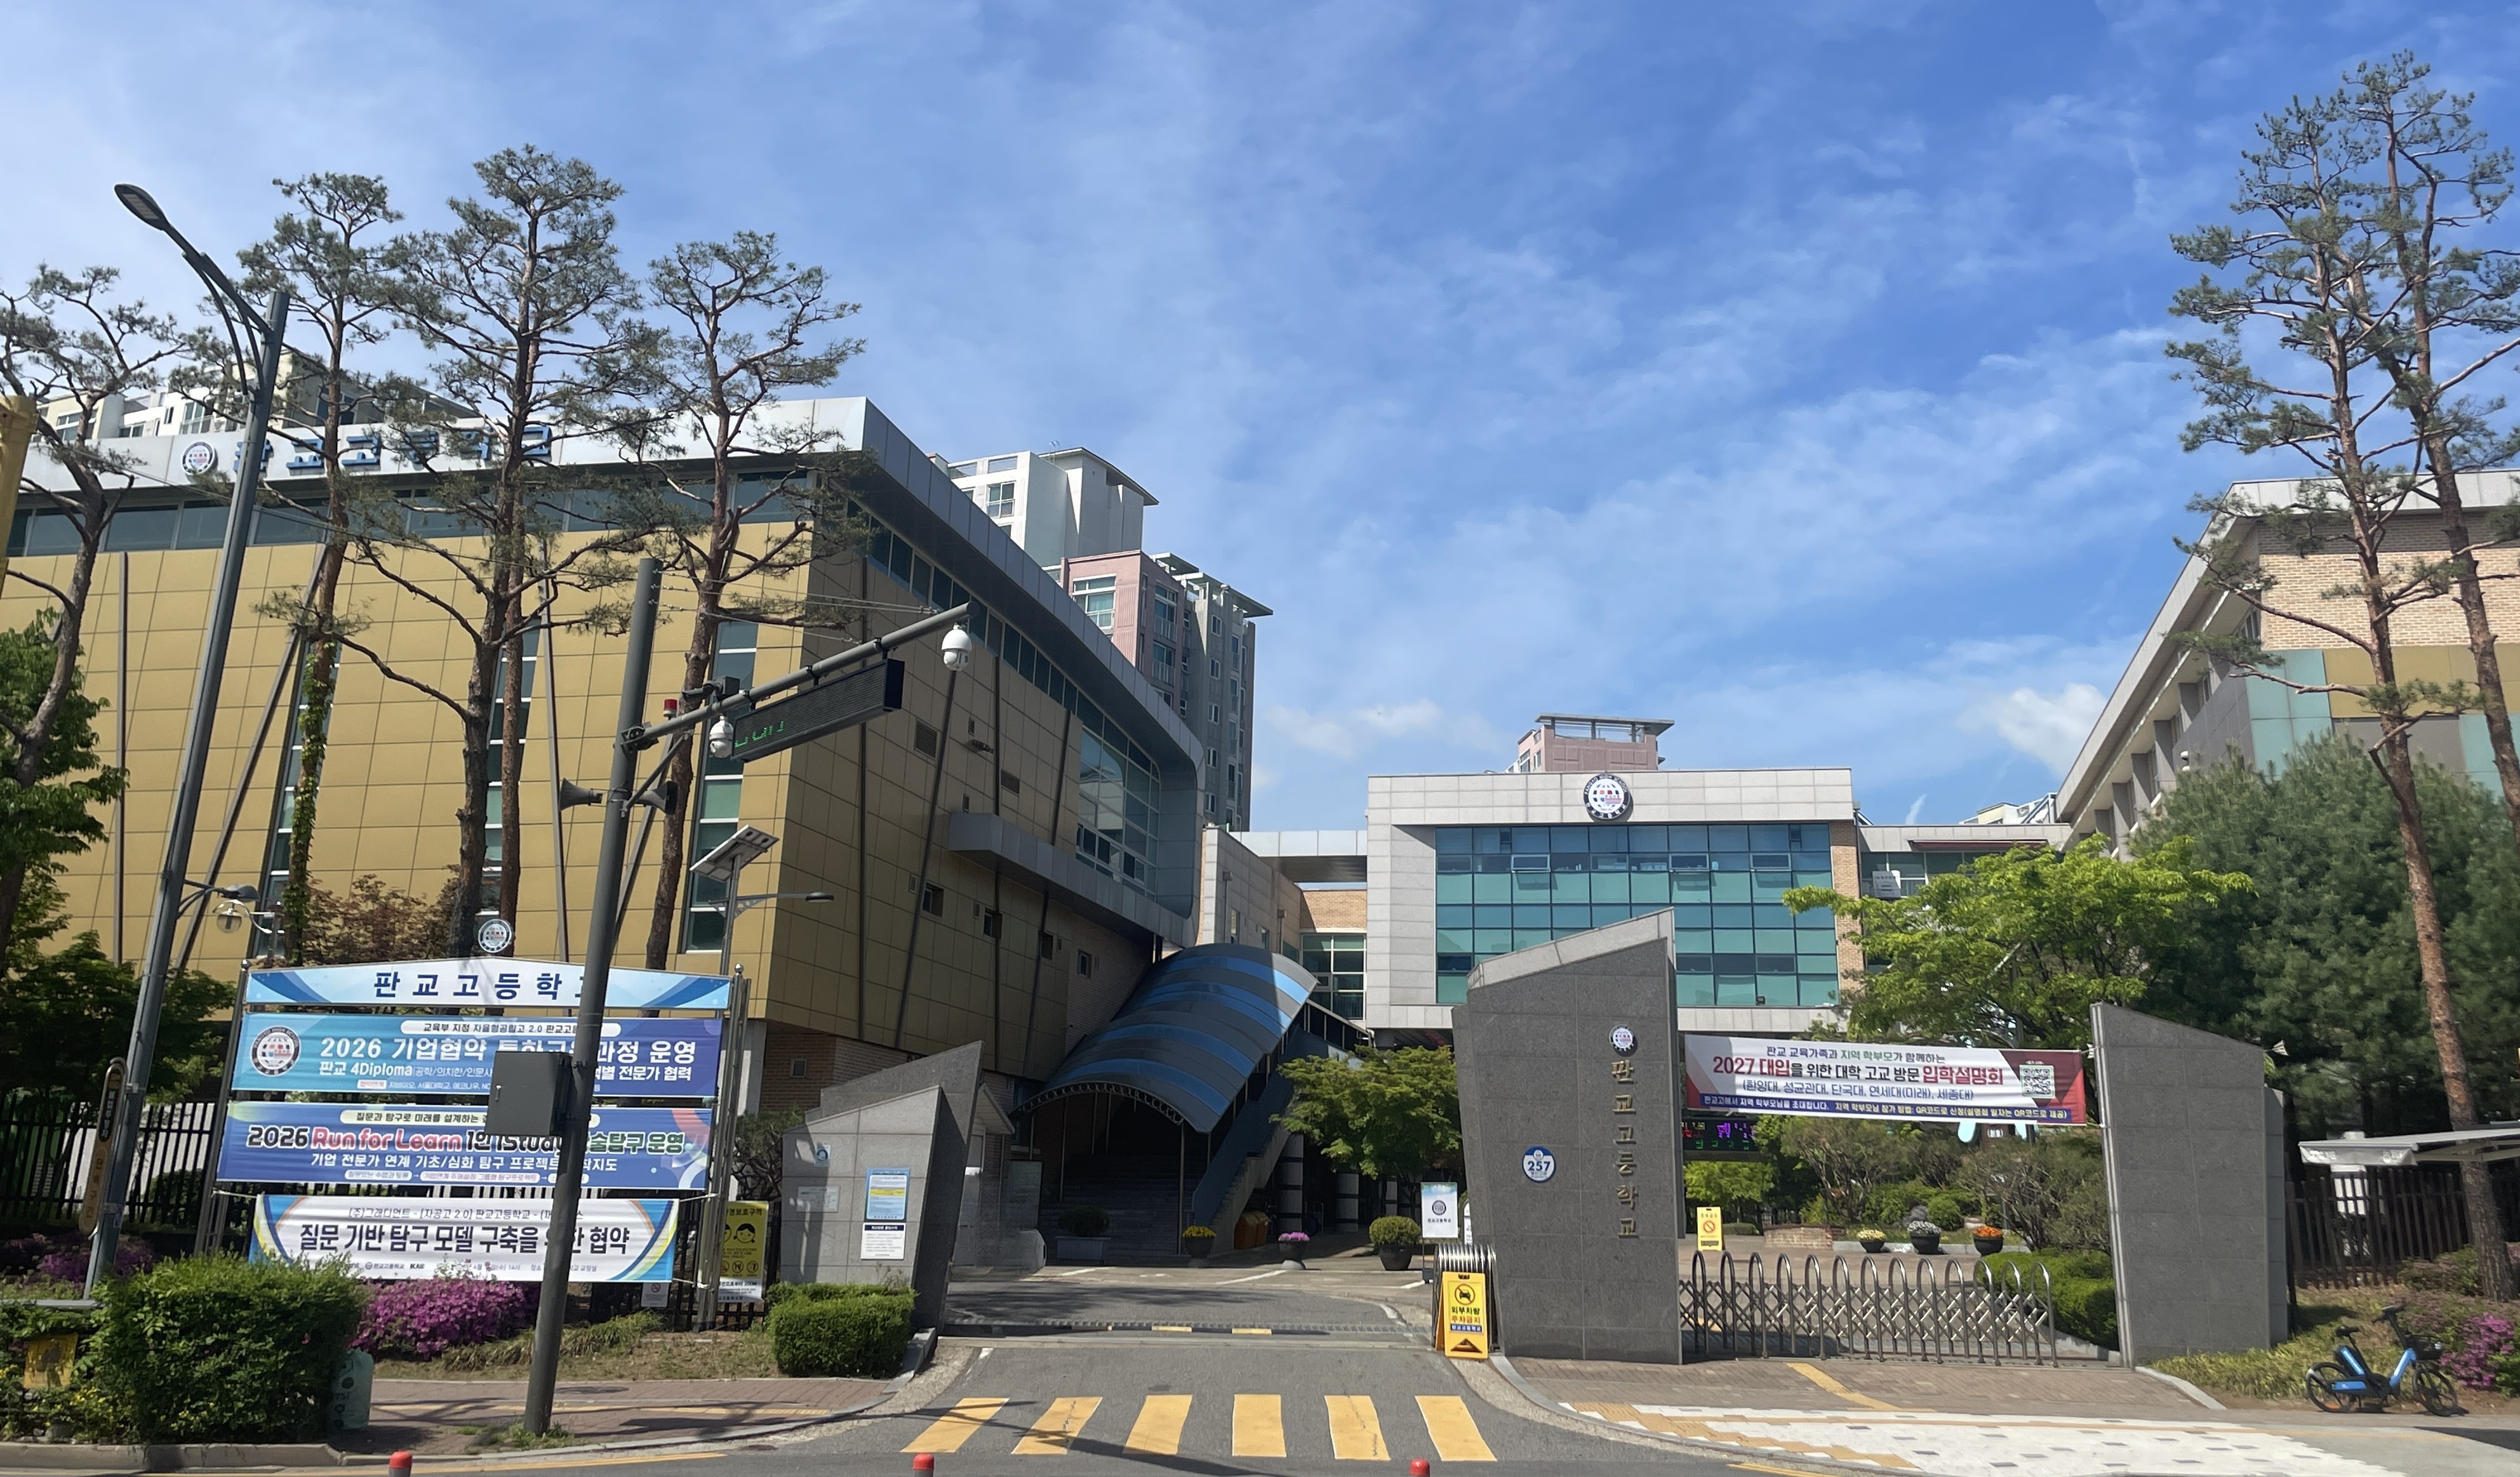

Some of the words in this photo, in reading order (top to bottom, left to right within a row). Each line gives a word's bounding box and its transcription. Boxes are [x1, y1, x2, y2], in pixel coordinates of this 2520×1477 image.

[373, 971, 584, 1000] 판교고등학
[423, 1023, 449, 1033] 교육부
[452, 1023, 470, 1033] 지정
[528, 1024, 543, 1033] 2.0
[320, 1037, 382, 1059] 2026
[391, 1037, 487, 1061] 기업협약
[650, 1040, 696, 1064] 운영
[1767, 1046, 1787, 1057] 판교
[1789, 1047, 1838, 1059] 교육가족과
[1841, 1050, 1861, 1060] 지역
[1863, 1050, 1903, 1062] 학부모가
[1905, 1052, 1946, 1064] 함께하는
[319, 1061, 347, 1076] 판교
[618, 1066, 660, 1081] 전문가
[663, 1066, 691, 1081] 협력
[1713, 1056, 1756, 1075] 2027
[1759, 1058, 1803, 1077] 대입을
[1807, 1062, 1832, 1078] 위한
[1836, 1064, 1862, 1080] 대학
[1865, 1066, 1891, 1082] 고교
[1894, 1067, 1920, 1083] 방문
[1923, 1065, 2003, 1085] 입학설명회
[356, 1112, 382, 1122] 질문과
[385, 1113, 411, 1122] 탐구로
[415, 1113, 441, 1123] 미래를
[444, 1114, 479, 1123] 설계하는
[248, 1125, 310, 1148] 2026
[312, 1128, 356, 1149] Run
[359, 1129, 392, 1150] for
[396, 1129, 462, 1151] Learn
[588, 1132, 645, 1154] 술탐구
[648, 1132, 684, 1154] 운영
[311, 1153, 337, 1167] 기업
[342, 1154, 380, 1167] 전문가
[385, 1155, 410, 1168] 연계
[415, 1155, 474, 1169] 기초/심화
[479, 1156, 505, 1169] 탐구
[510, 1157, 559, 1170] 프로젝트
[1528, 1161, 1550, 1171] 257
[454, 1209, 472, 1220] 2.0]
[476, 1209, 530, 1220] 판교고등학교
[726, 1209, 763, 1217] 경보호구역
[300, 1224, 339, 1251] 질문
[344, 1224, 385, 1251] 기반
[390, 1225, 429, 1252] 탐구
[434, 1226, 474, 1253] 모델
[479, 1226, 538, 1254] 구축을
[589, 1226, 630, 1255] 협약
